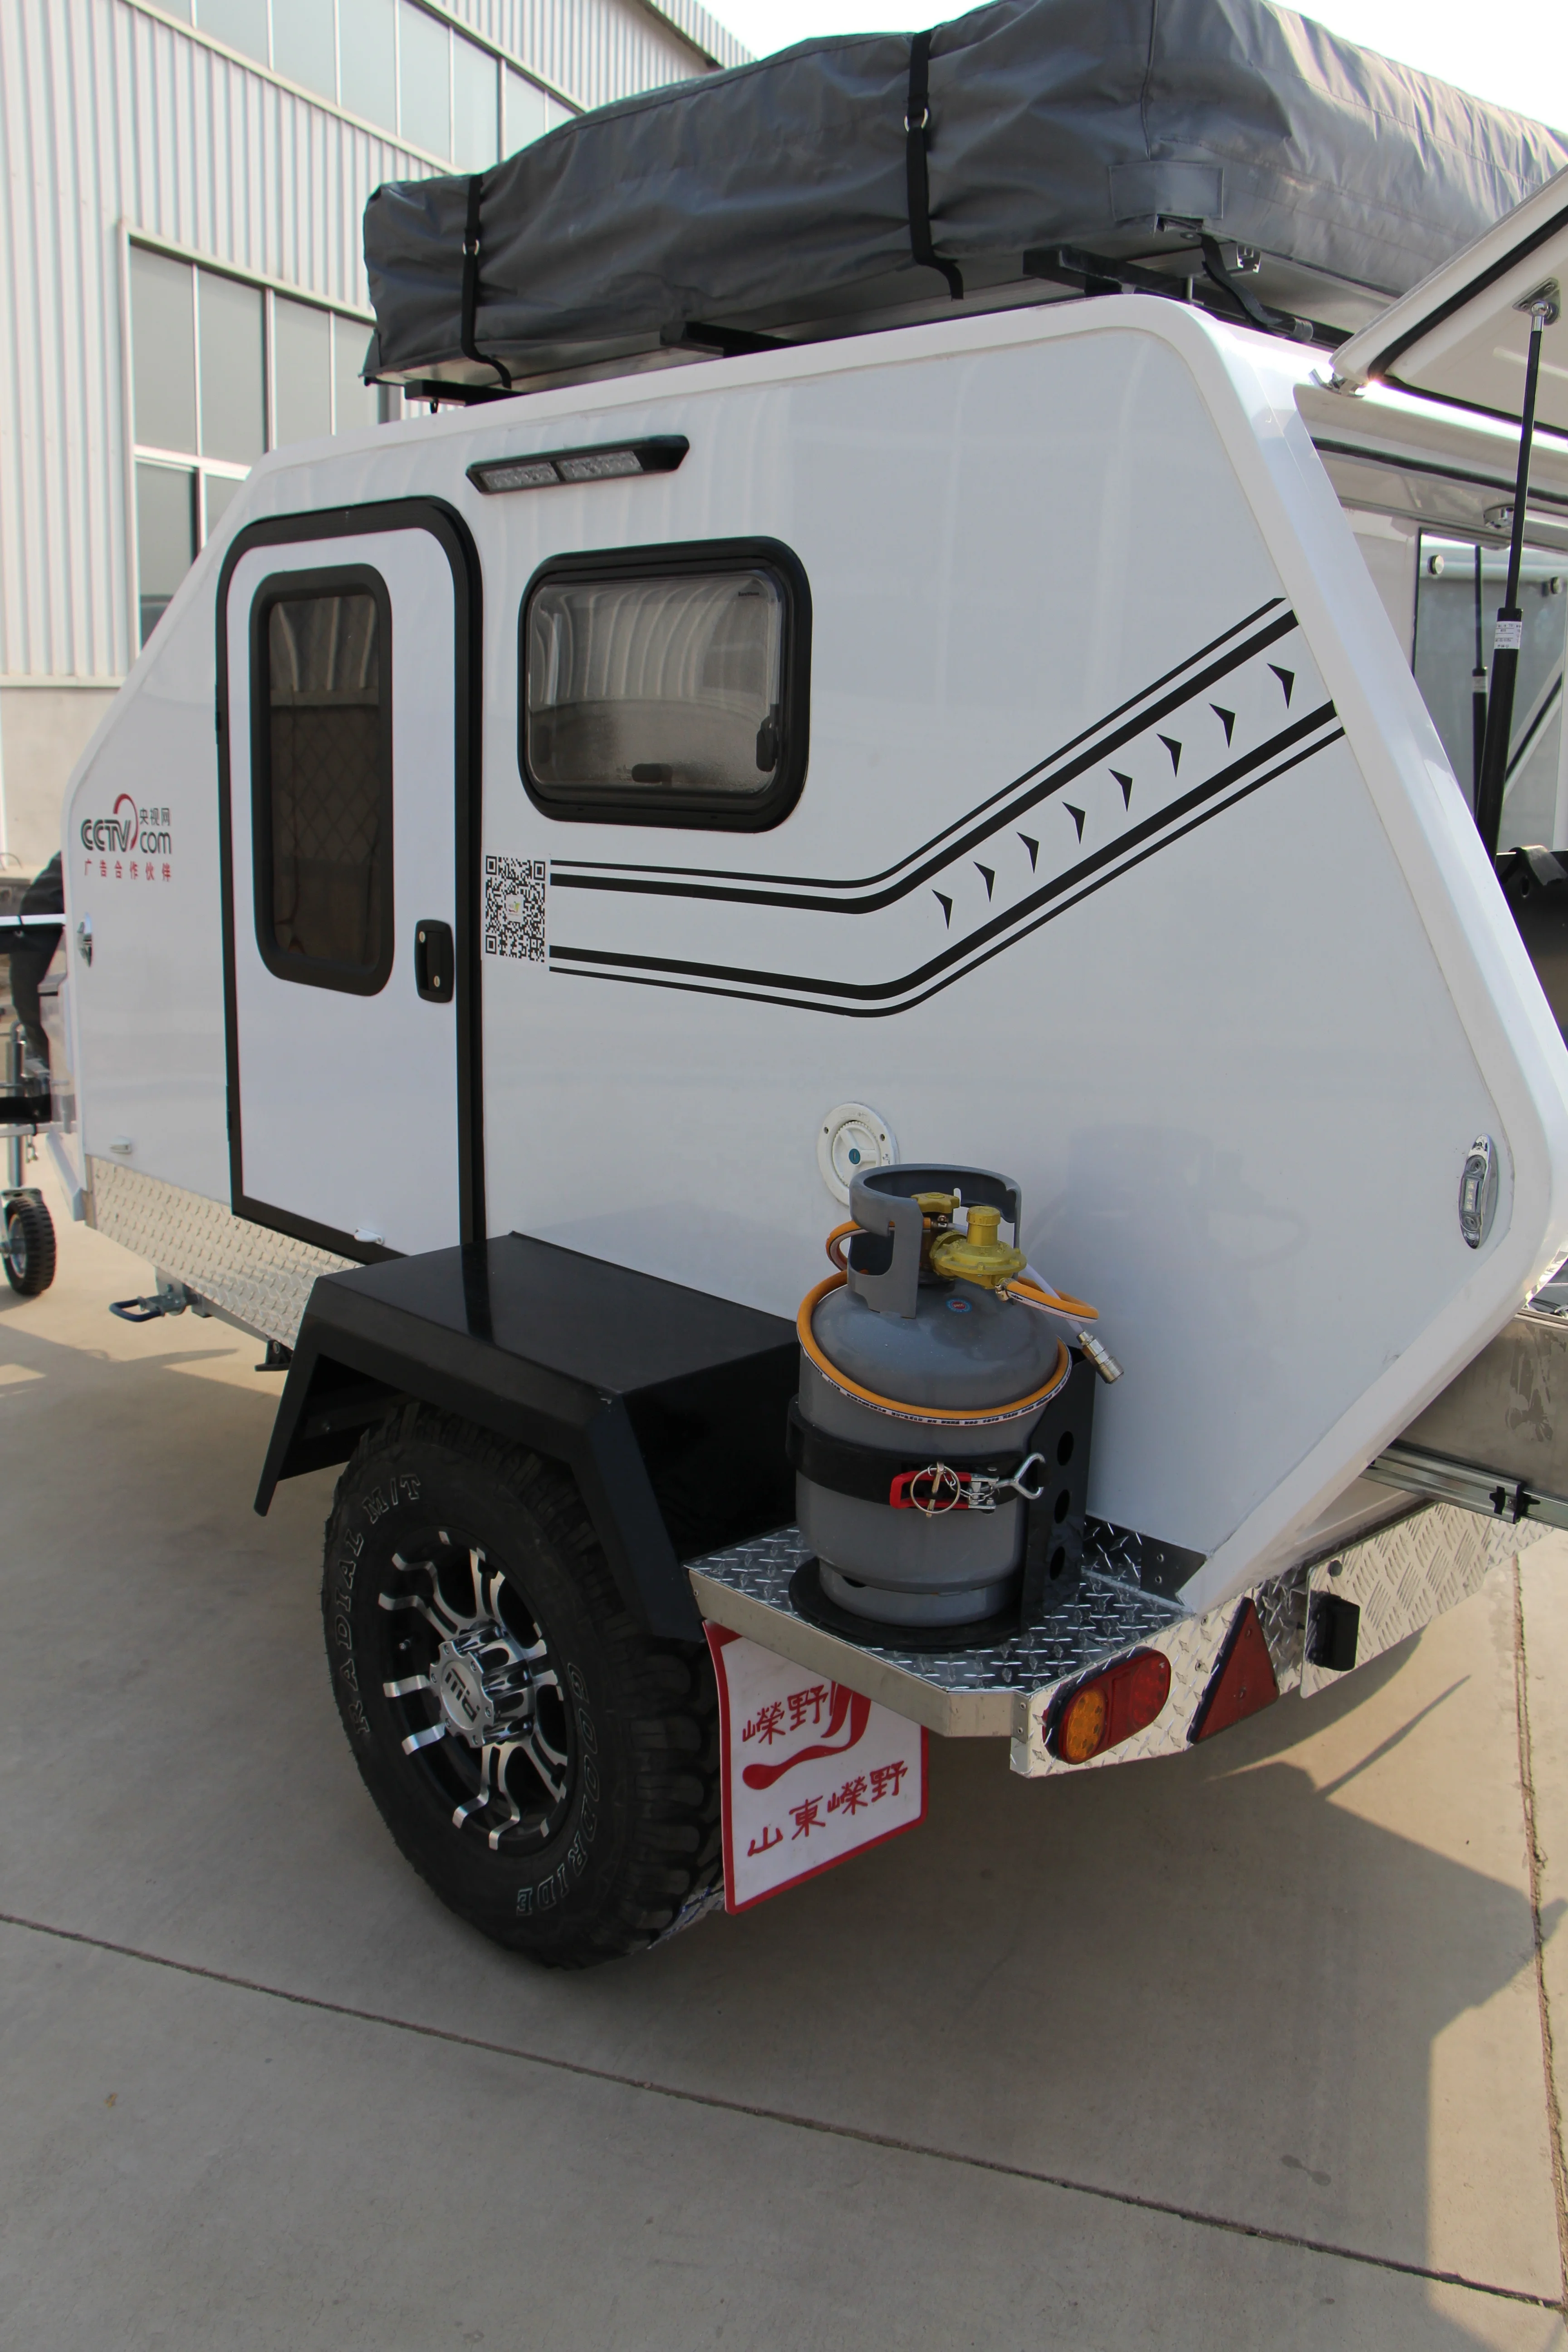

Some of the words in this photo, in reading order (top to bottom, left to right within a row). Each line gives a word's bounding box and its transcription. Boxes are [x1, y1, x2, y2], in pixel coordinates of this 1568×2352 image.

[139, 807, 171, 827] 央视网
[80, 818, 132, 852] CCTV
[139, 831, 172, 854] com
[84, 858, 172, 882] 广告合作伙伴
[335, 1529, 371, 1735] RADIAL
[363, 1474, 421, 1525] M/T
[516, 1661, 600, 1916] GOODRIDE
